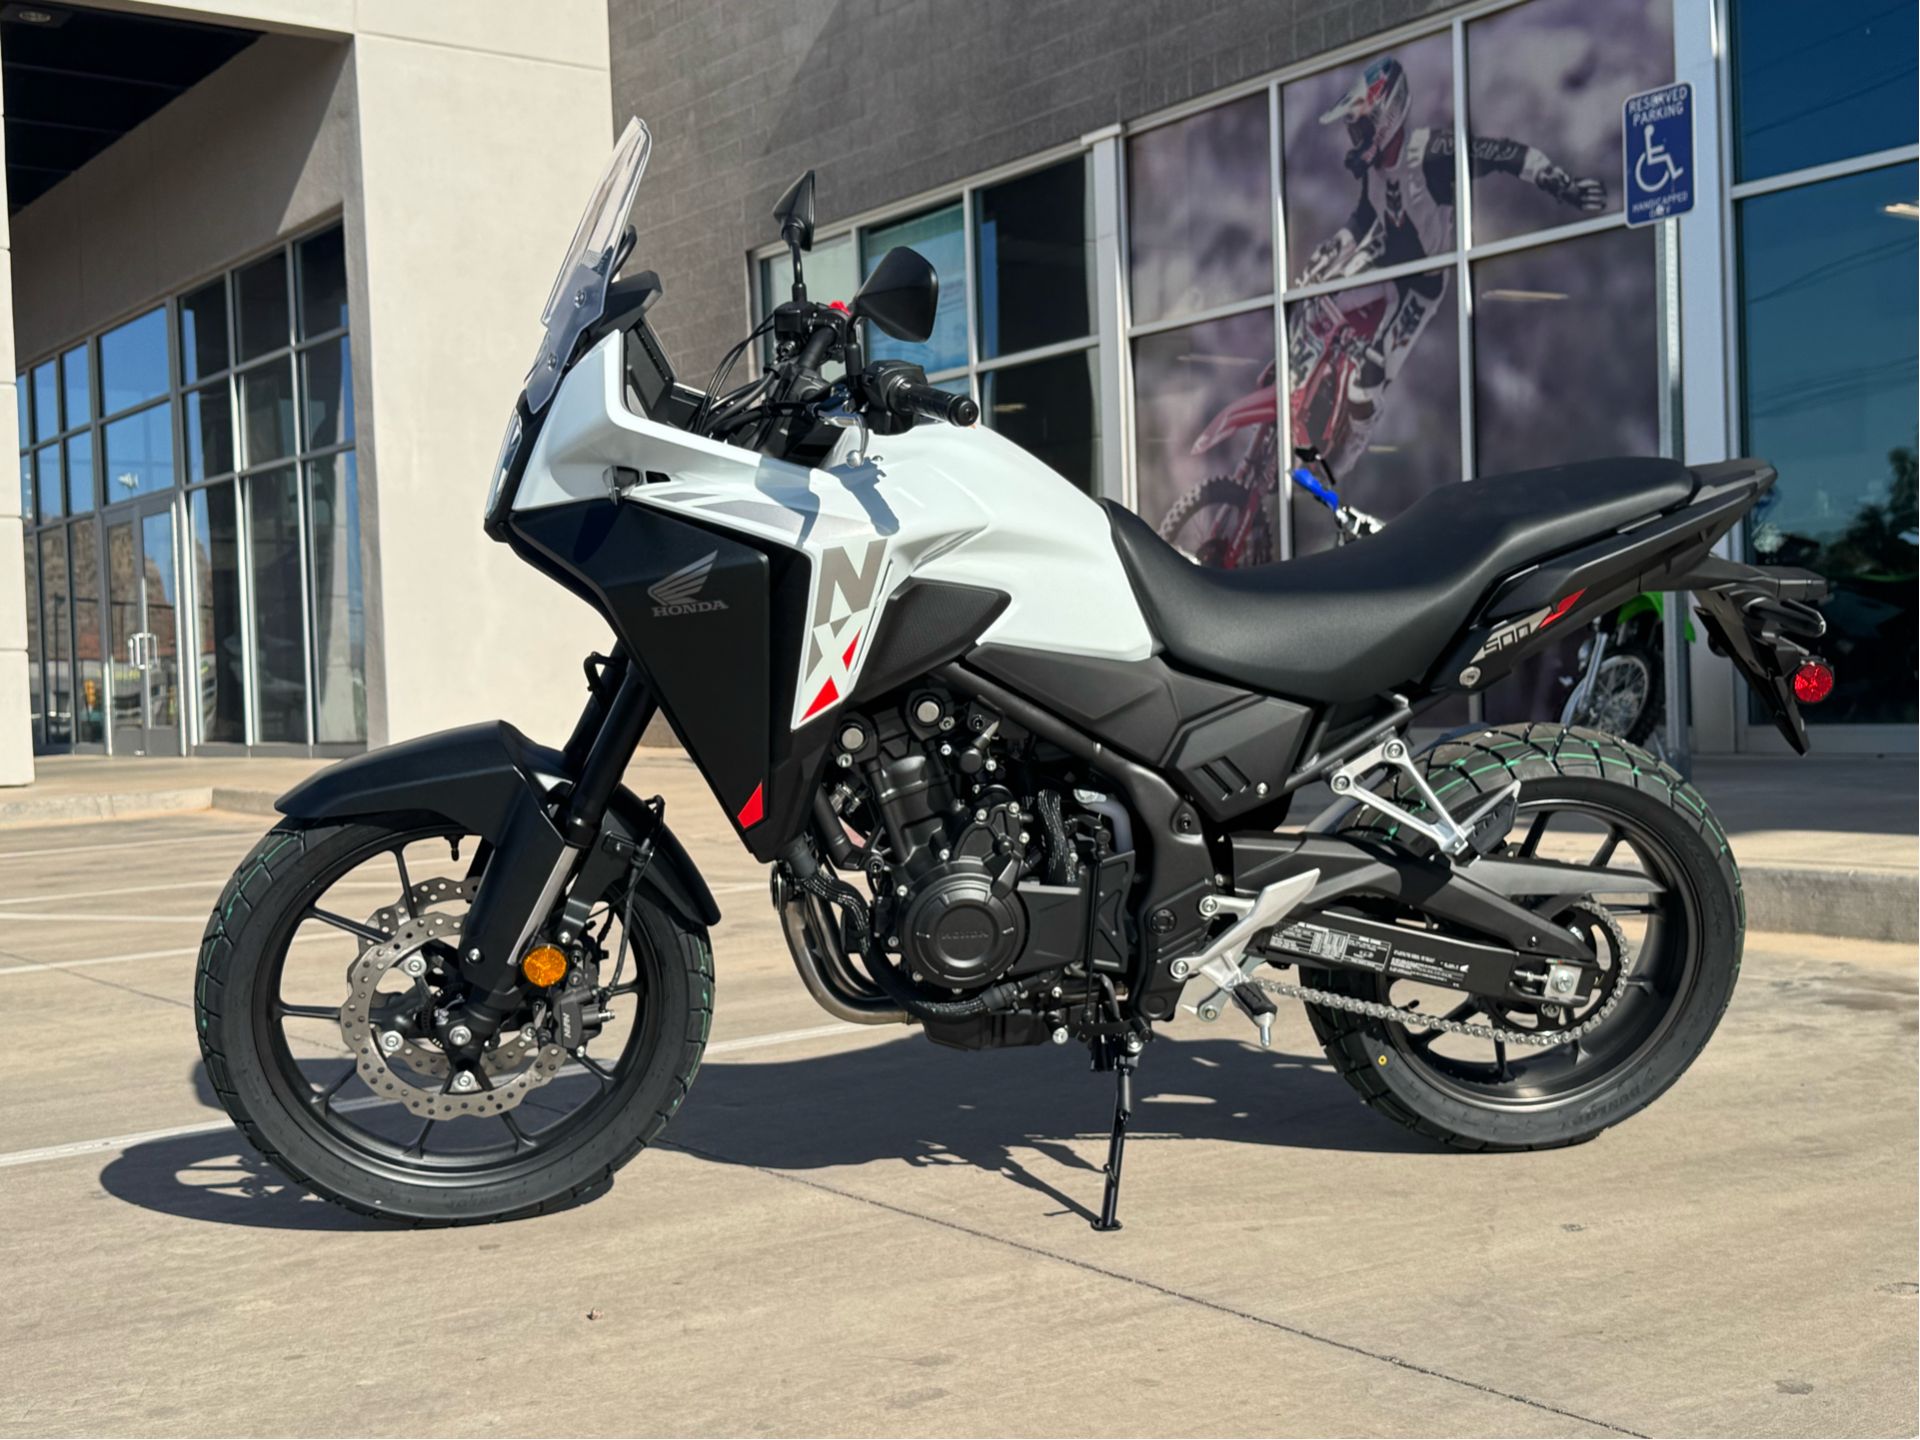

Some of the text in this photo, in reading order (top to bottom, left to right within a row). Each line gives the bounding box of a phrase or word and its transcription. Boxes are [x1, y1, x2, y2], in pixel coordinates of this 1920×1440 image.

[1632, 101, 1684, 127] PARKING
[1632, 191, 1688, 213] HANDICAPPED
[651, 599, 729, 617] HONDA
[1483, 621, 1533, 655] 500
